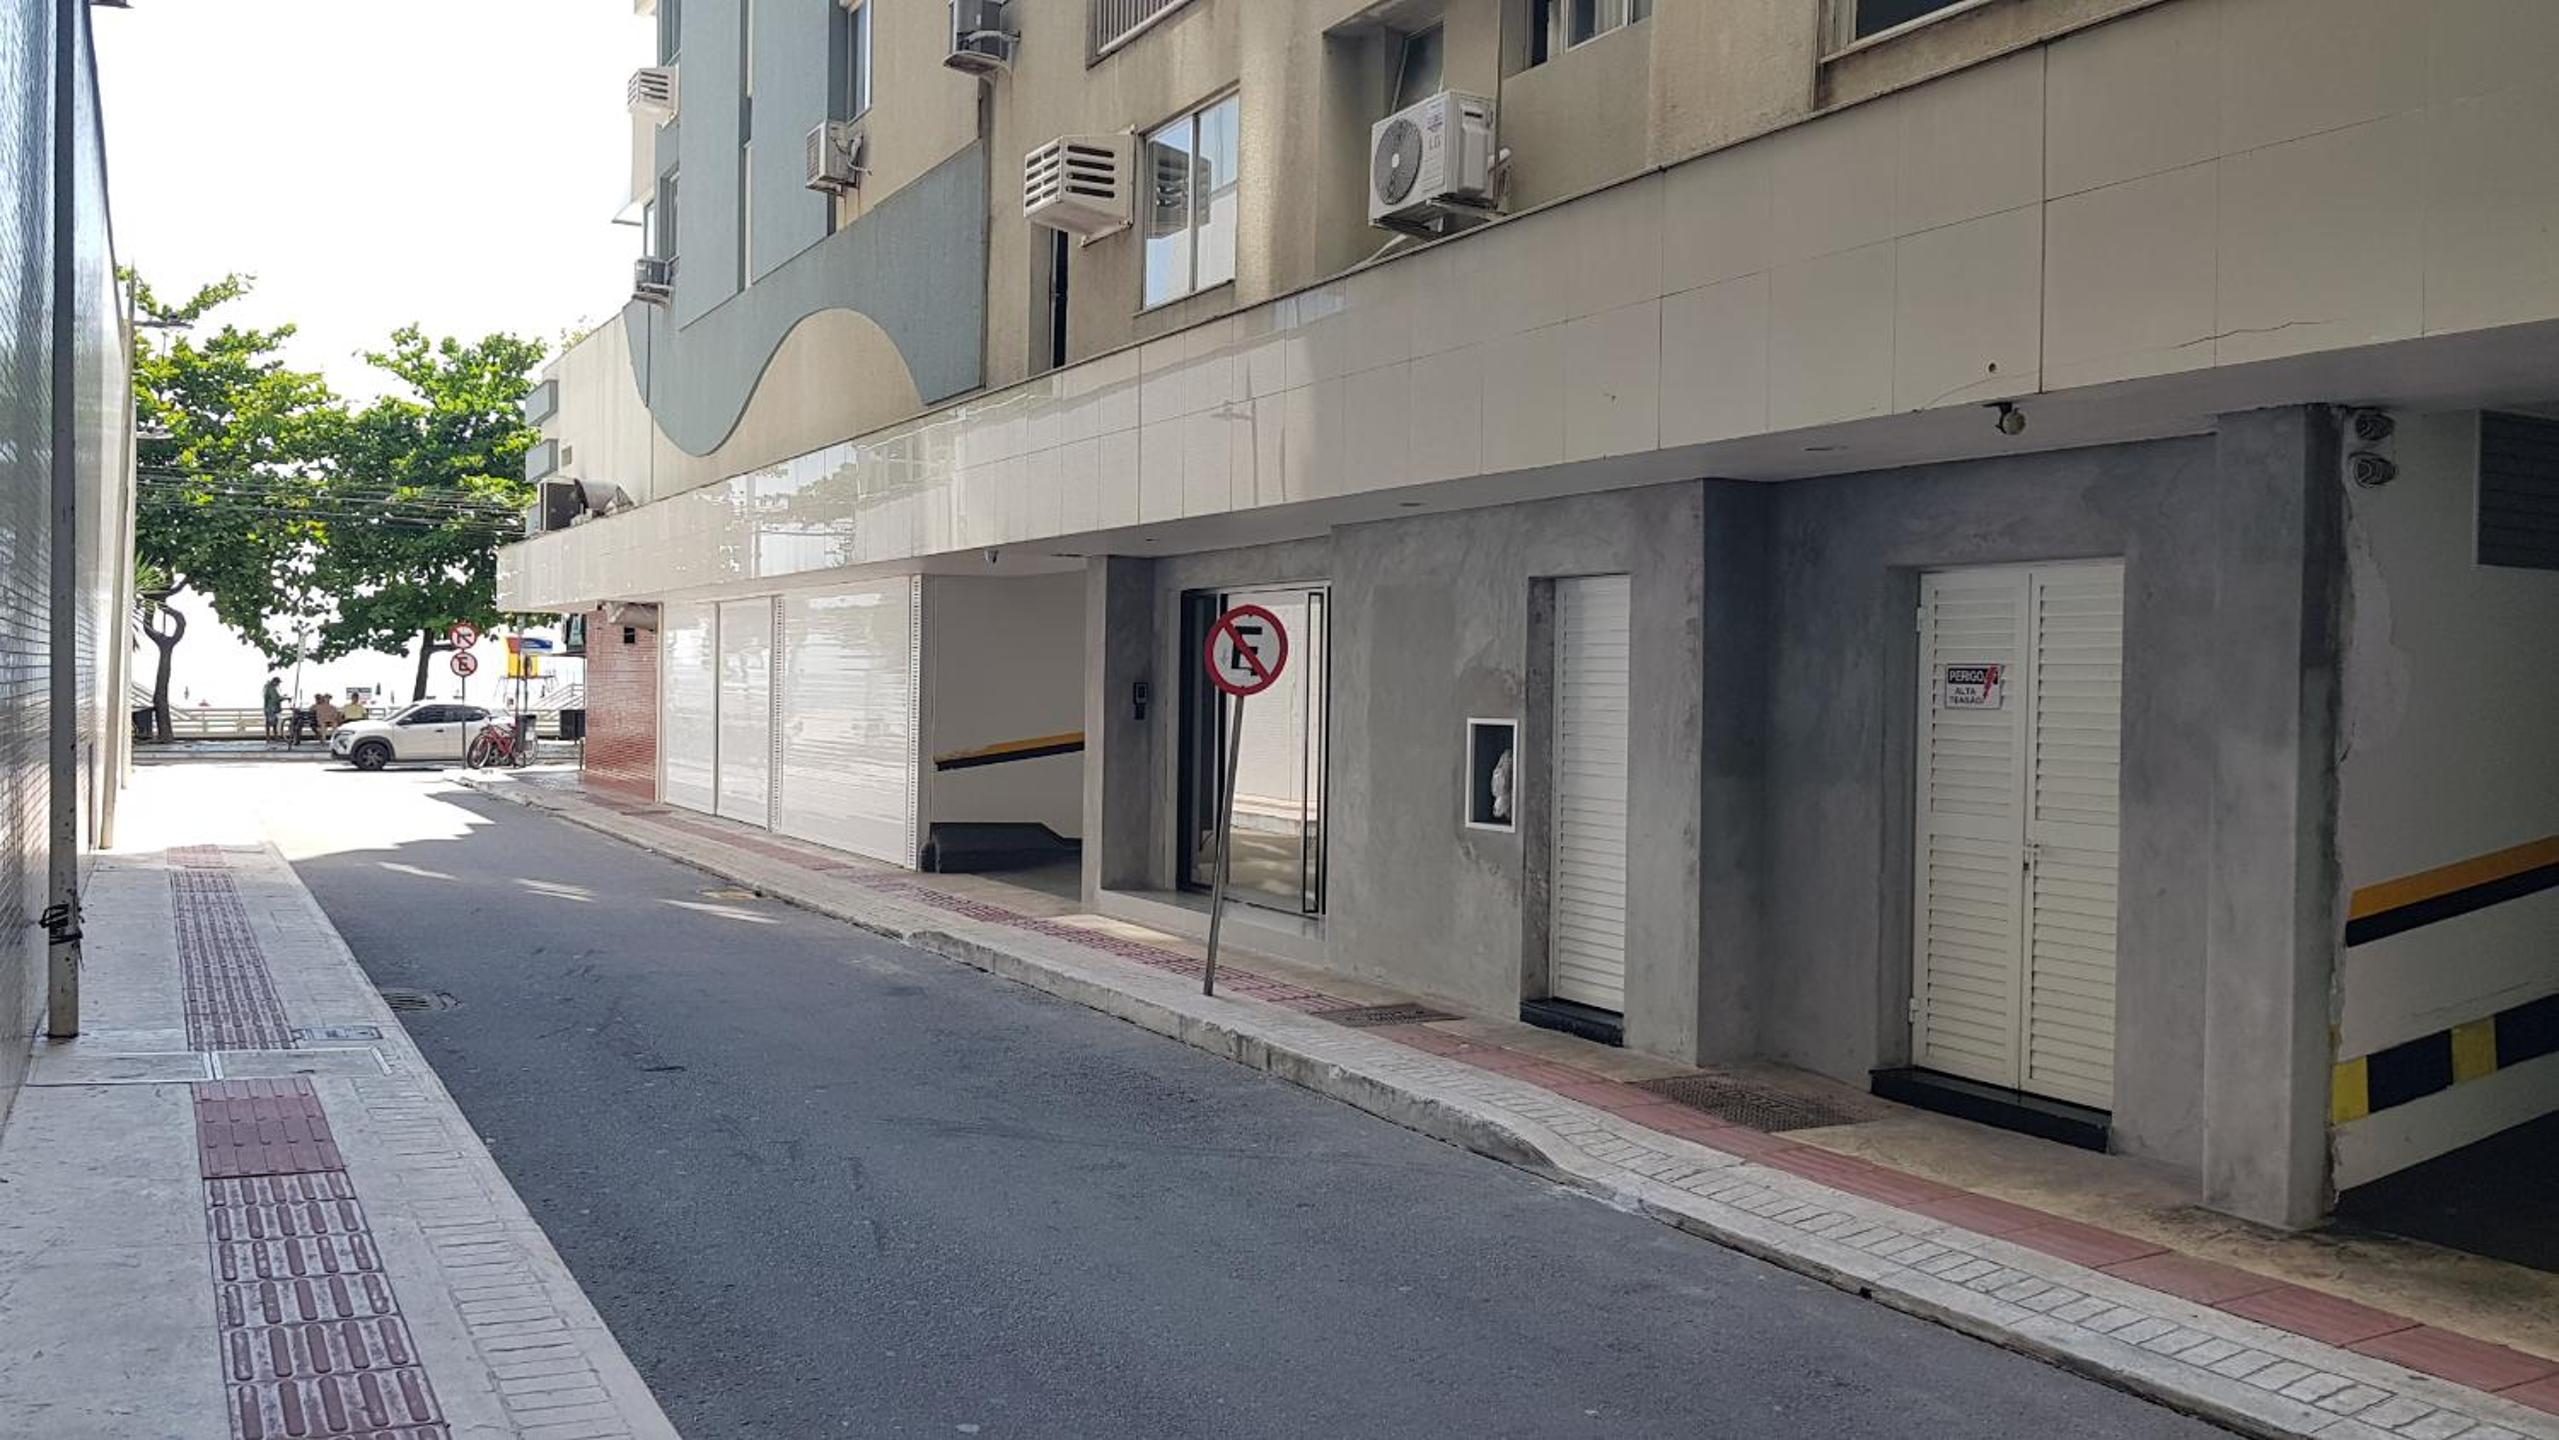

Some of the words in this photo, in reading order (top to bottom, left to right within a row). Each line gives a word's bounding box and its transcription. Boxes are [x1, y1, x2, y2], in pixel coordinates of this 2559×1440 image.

[1231, 625, 1262, 675] E
[1949, 670, 1985, 682] PERIGO
[1955, 687, 1977, 695] ALTA
